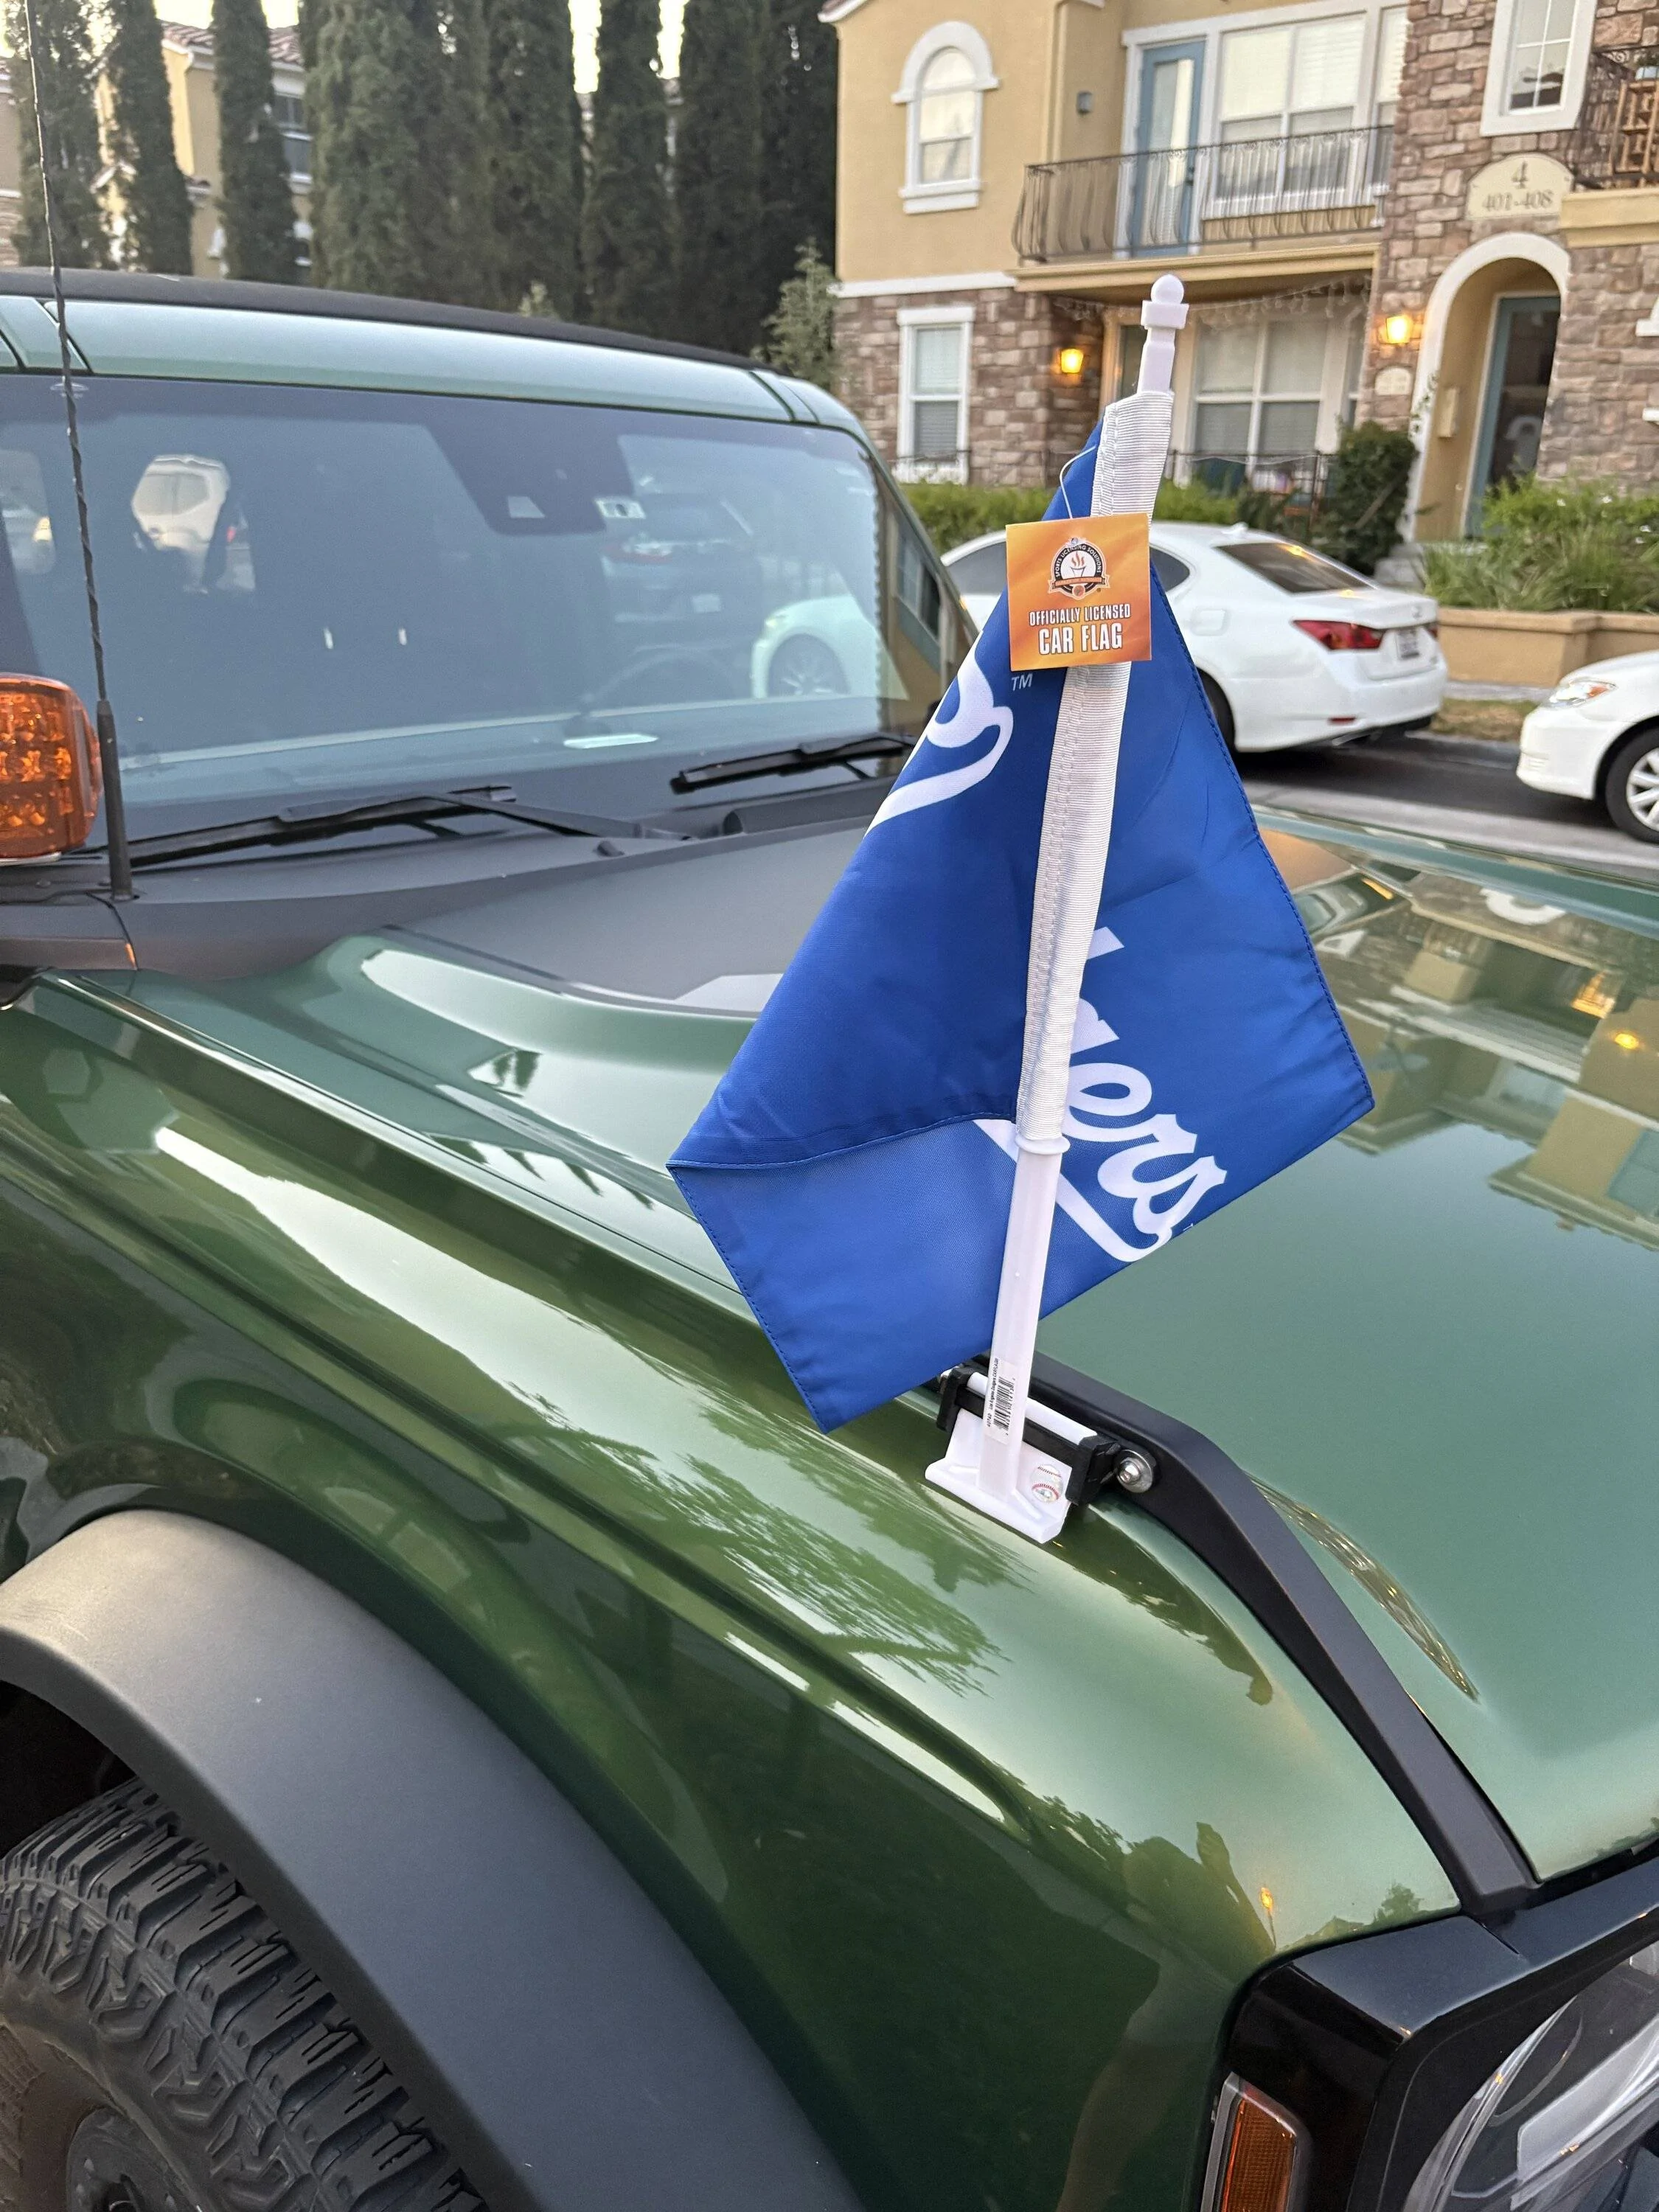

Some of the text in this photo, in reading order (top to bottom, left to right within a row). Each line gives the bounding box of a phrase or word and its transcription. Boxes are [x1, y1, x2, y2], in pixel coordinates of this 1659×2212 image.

[1511, 161, 1528, 189] 4
[1054, 558, 1062, 577] SPORTS
[1087, 547, 1102, 573] SOLUTIONS
[1029, 603, 1131, 626] OFFICIALLY LICENSED
[1038, 622, 1123, 655] CAR FLAG
[1012, 673, 1032, 691] TM
